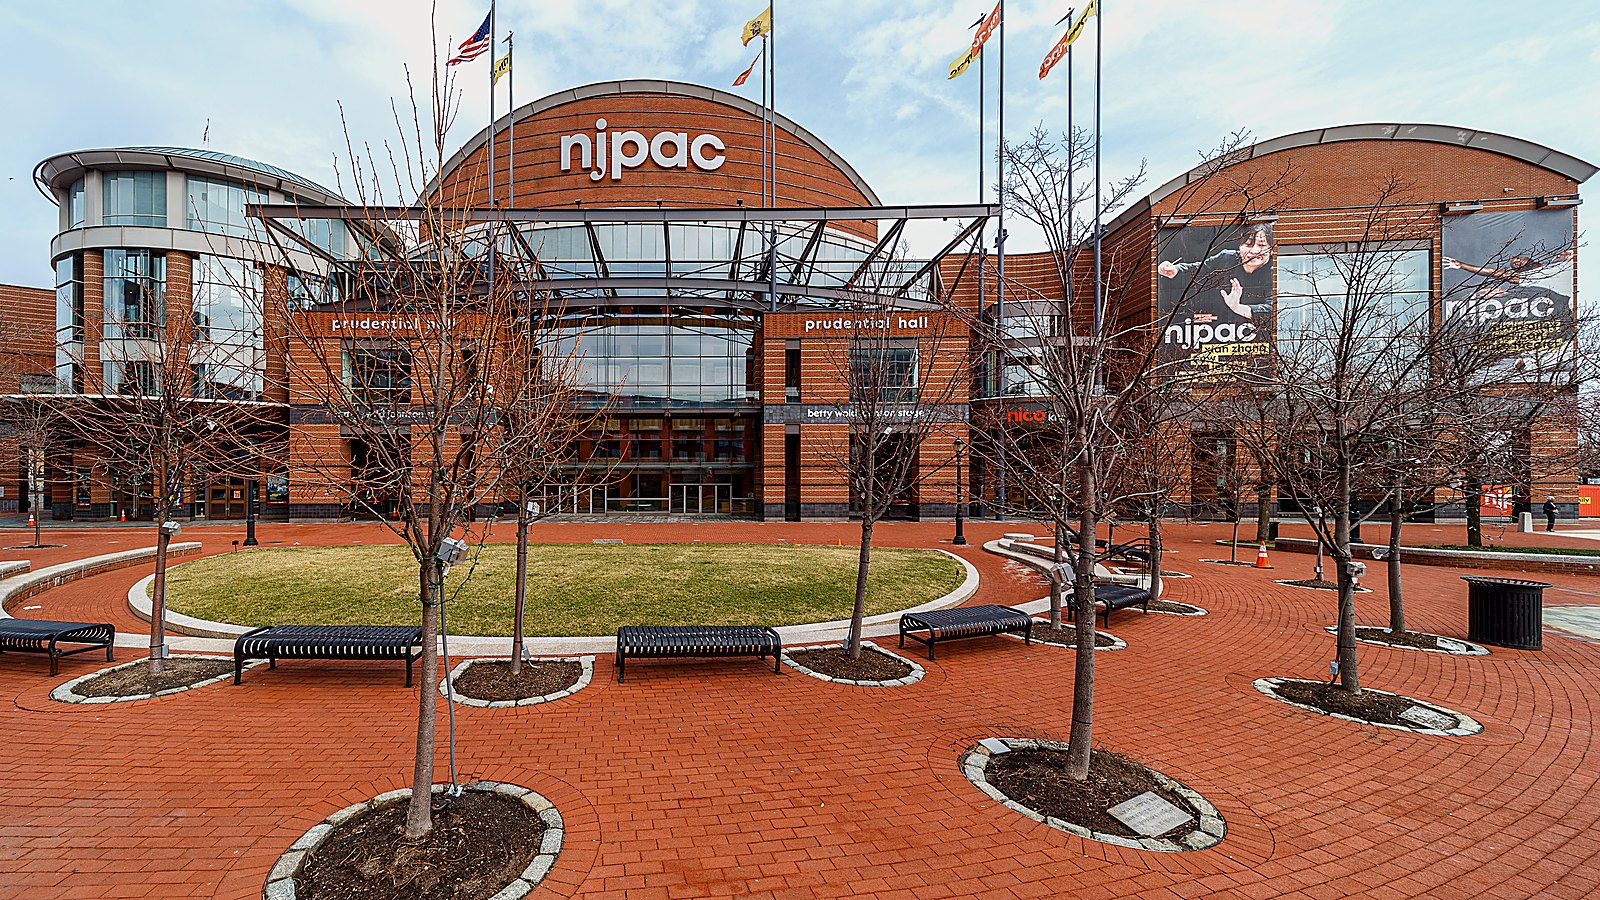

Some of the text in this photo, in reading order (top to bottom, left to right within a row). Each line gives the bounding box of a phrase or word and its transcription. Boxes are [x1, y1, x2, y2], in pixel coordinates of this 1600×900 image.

[560, 118, 726, 181] njpac
[1446, 292, 1555, 327] njpac
[332, 317, 419, 332] prudential
[805, 316, 928, 332] prudential hall
[1165, 318, 1257, 350] njpac
[1231, 343, 1267, 354] zhang
[807, 408, 834, 419] betty
[1007, 406, 1047, 423] nico
